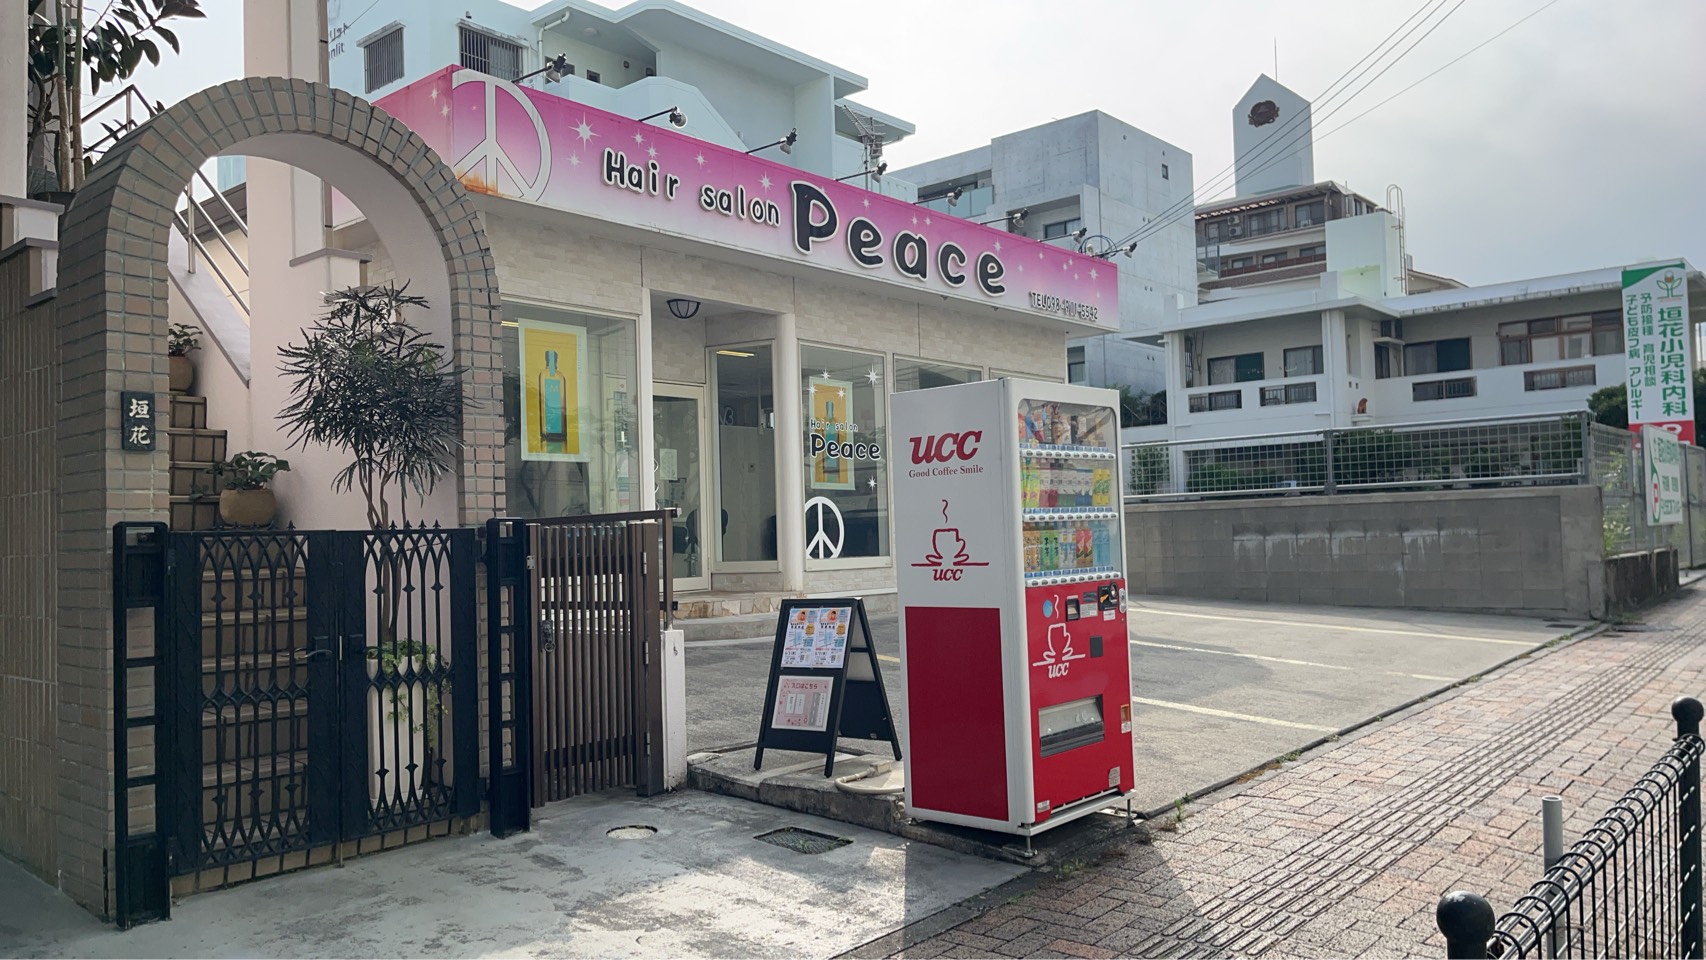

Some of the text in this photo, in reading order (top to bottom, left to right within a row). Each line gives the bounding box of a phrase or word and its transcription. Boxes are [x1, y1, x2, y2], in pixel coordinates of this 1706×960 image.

[603, 147, 1006, 296] Hair salon Peace
[1657, 306, 1688, 417] 垣花小児科内科
[1629, 366, 1643, 420] アレルギー
[129, 398, 151, 445] 垣花
[810, 418, 859, 433] Hair salon
[810, 432, 881, 461] Peace
[908, 464, 984, 478] Good Coffee Smile
